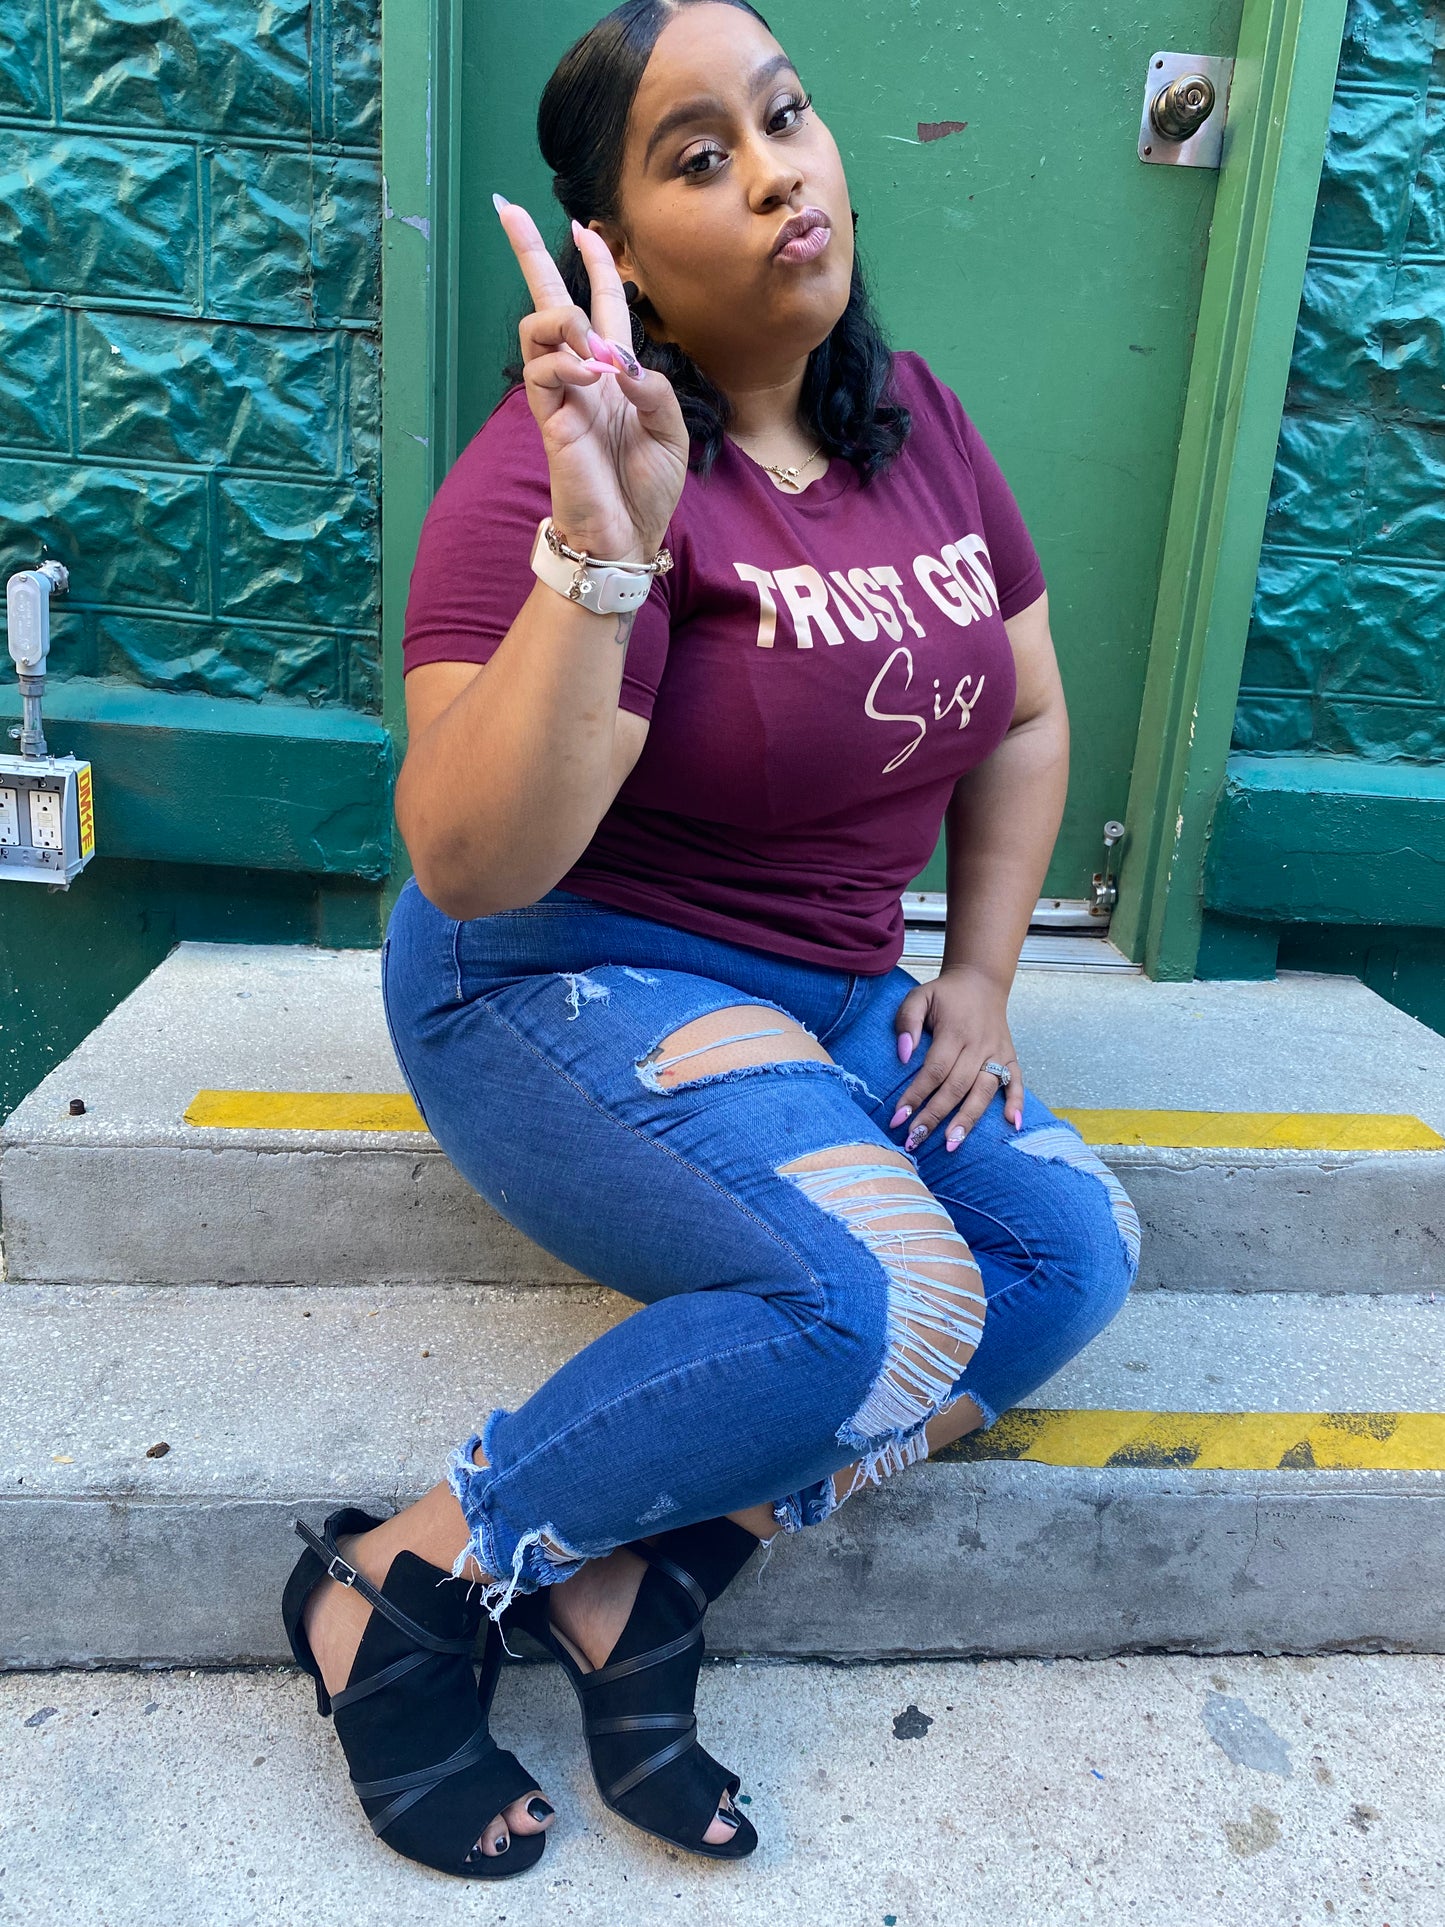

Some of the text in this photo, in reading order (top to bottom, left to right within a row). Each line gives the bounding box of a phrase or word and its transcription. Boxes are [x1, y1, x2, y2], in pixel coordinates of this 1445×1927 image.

[732, 533, 1000, 649] TRUST GOD
[864, 647, 986, 774] Sis
